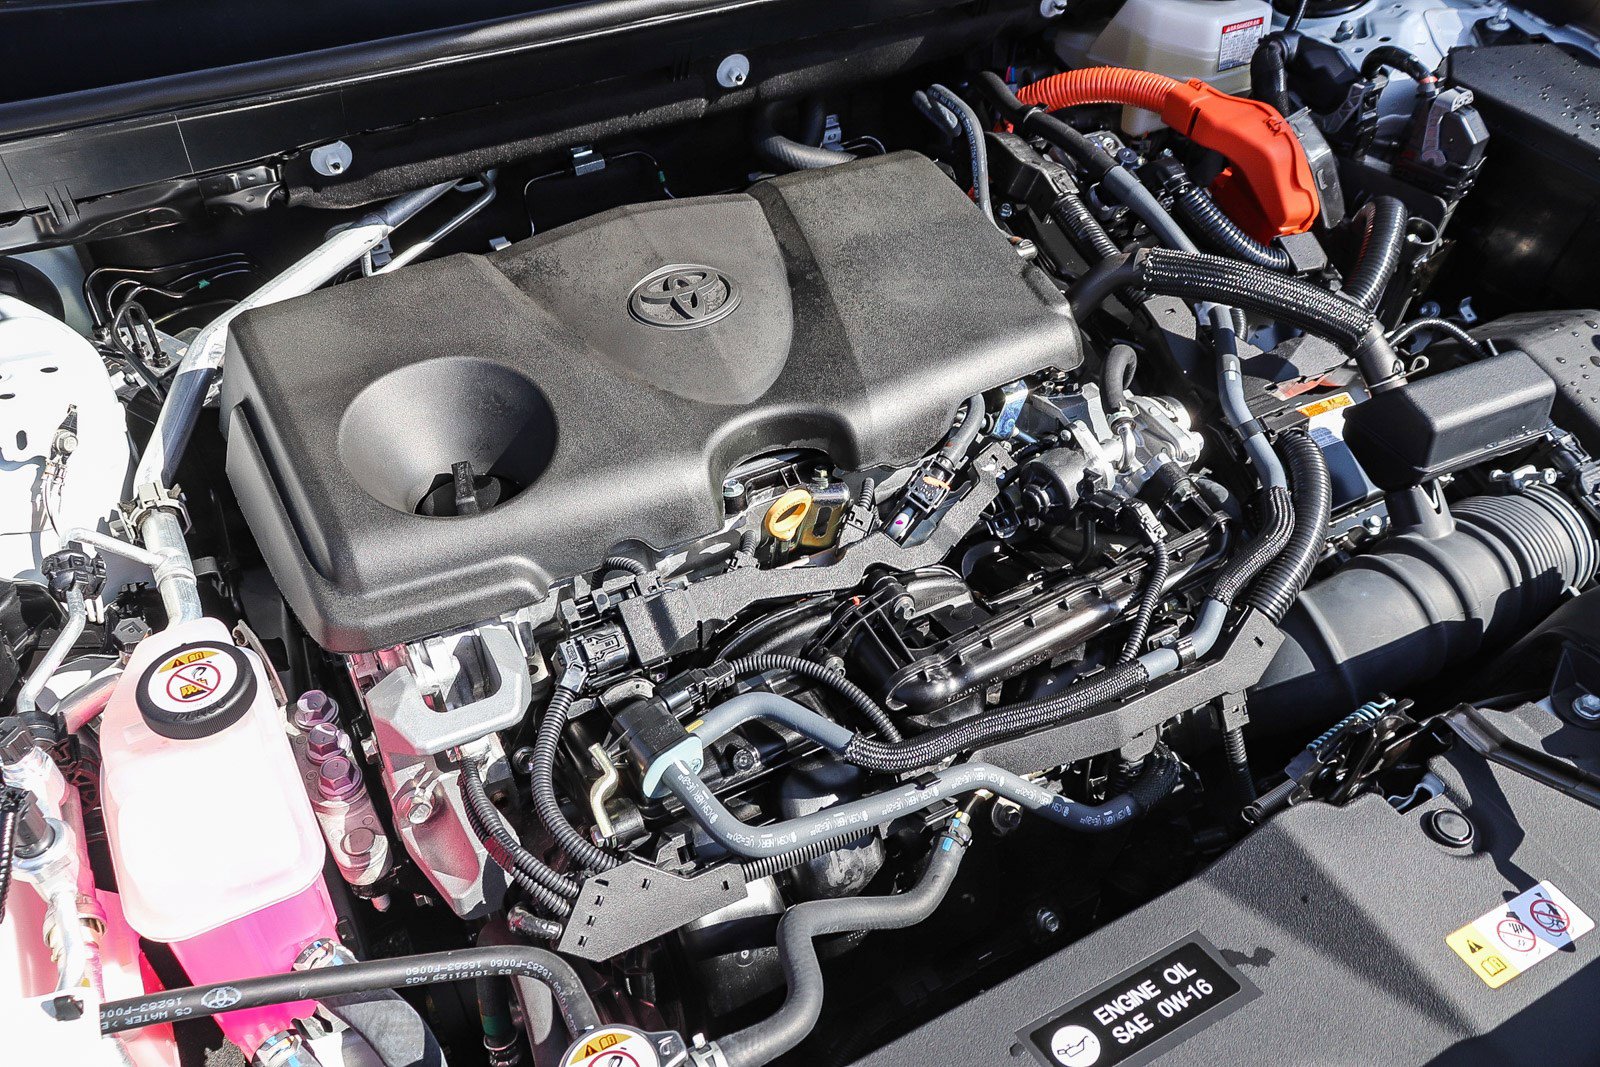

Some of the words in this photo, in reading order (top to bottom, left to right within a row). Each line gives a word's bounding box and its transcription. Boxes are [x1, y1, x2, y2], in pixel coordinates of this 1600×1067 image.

[125, 1010, 169, 1025] WATER
[1093, 979, 1161, 1026] ENGINE
[1163, 962, 1197, 985] OIL
[1112, 1012, 1155, 1044] SAE
[1157, 978, 1213, 1018] 0W-16
